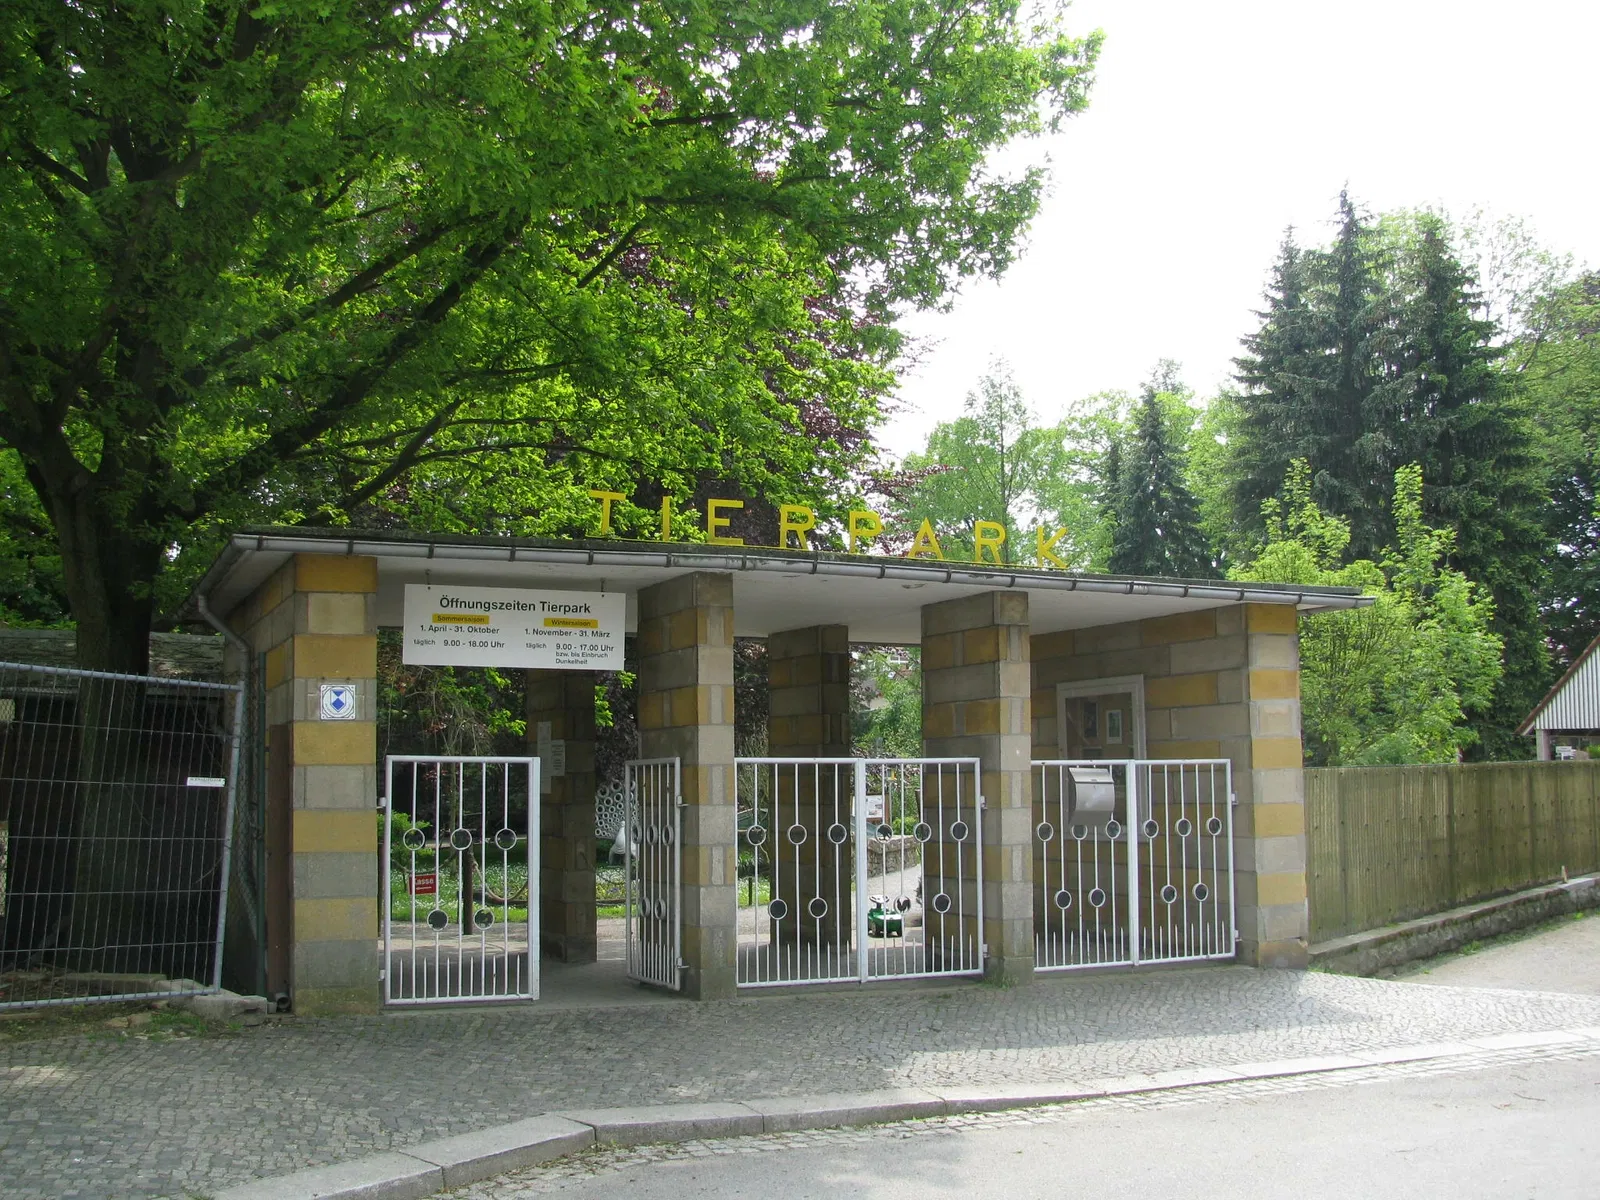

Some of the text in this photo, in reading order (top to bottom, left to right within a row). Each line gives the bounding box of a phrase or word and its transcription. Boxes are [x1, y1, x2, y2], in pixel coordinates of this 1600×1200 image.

[588, 490, 1068, 569] TIERPARK
[439, 594, 591, 615] Öffnungszeiten Tierpark
[437, 614, 485, 623] Sommersaison
[551, 619, 591, 627] Wintersaison
[428, 625, 447, 633] April
[467, 626, 500, 634] Oktober
[533, 628, 572, 637] November
[591, 630, 611, 638] März
[413, 638, 436, 646] täglich
[469, 640, 489, 648] 18.00
[601, 644, 615, 652] Uhr
